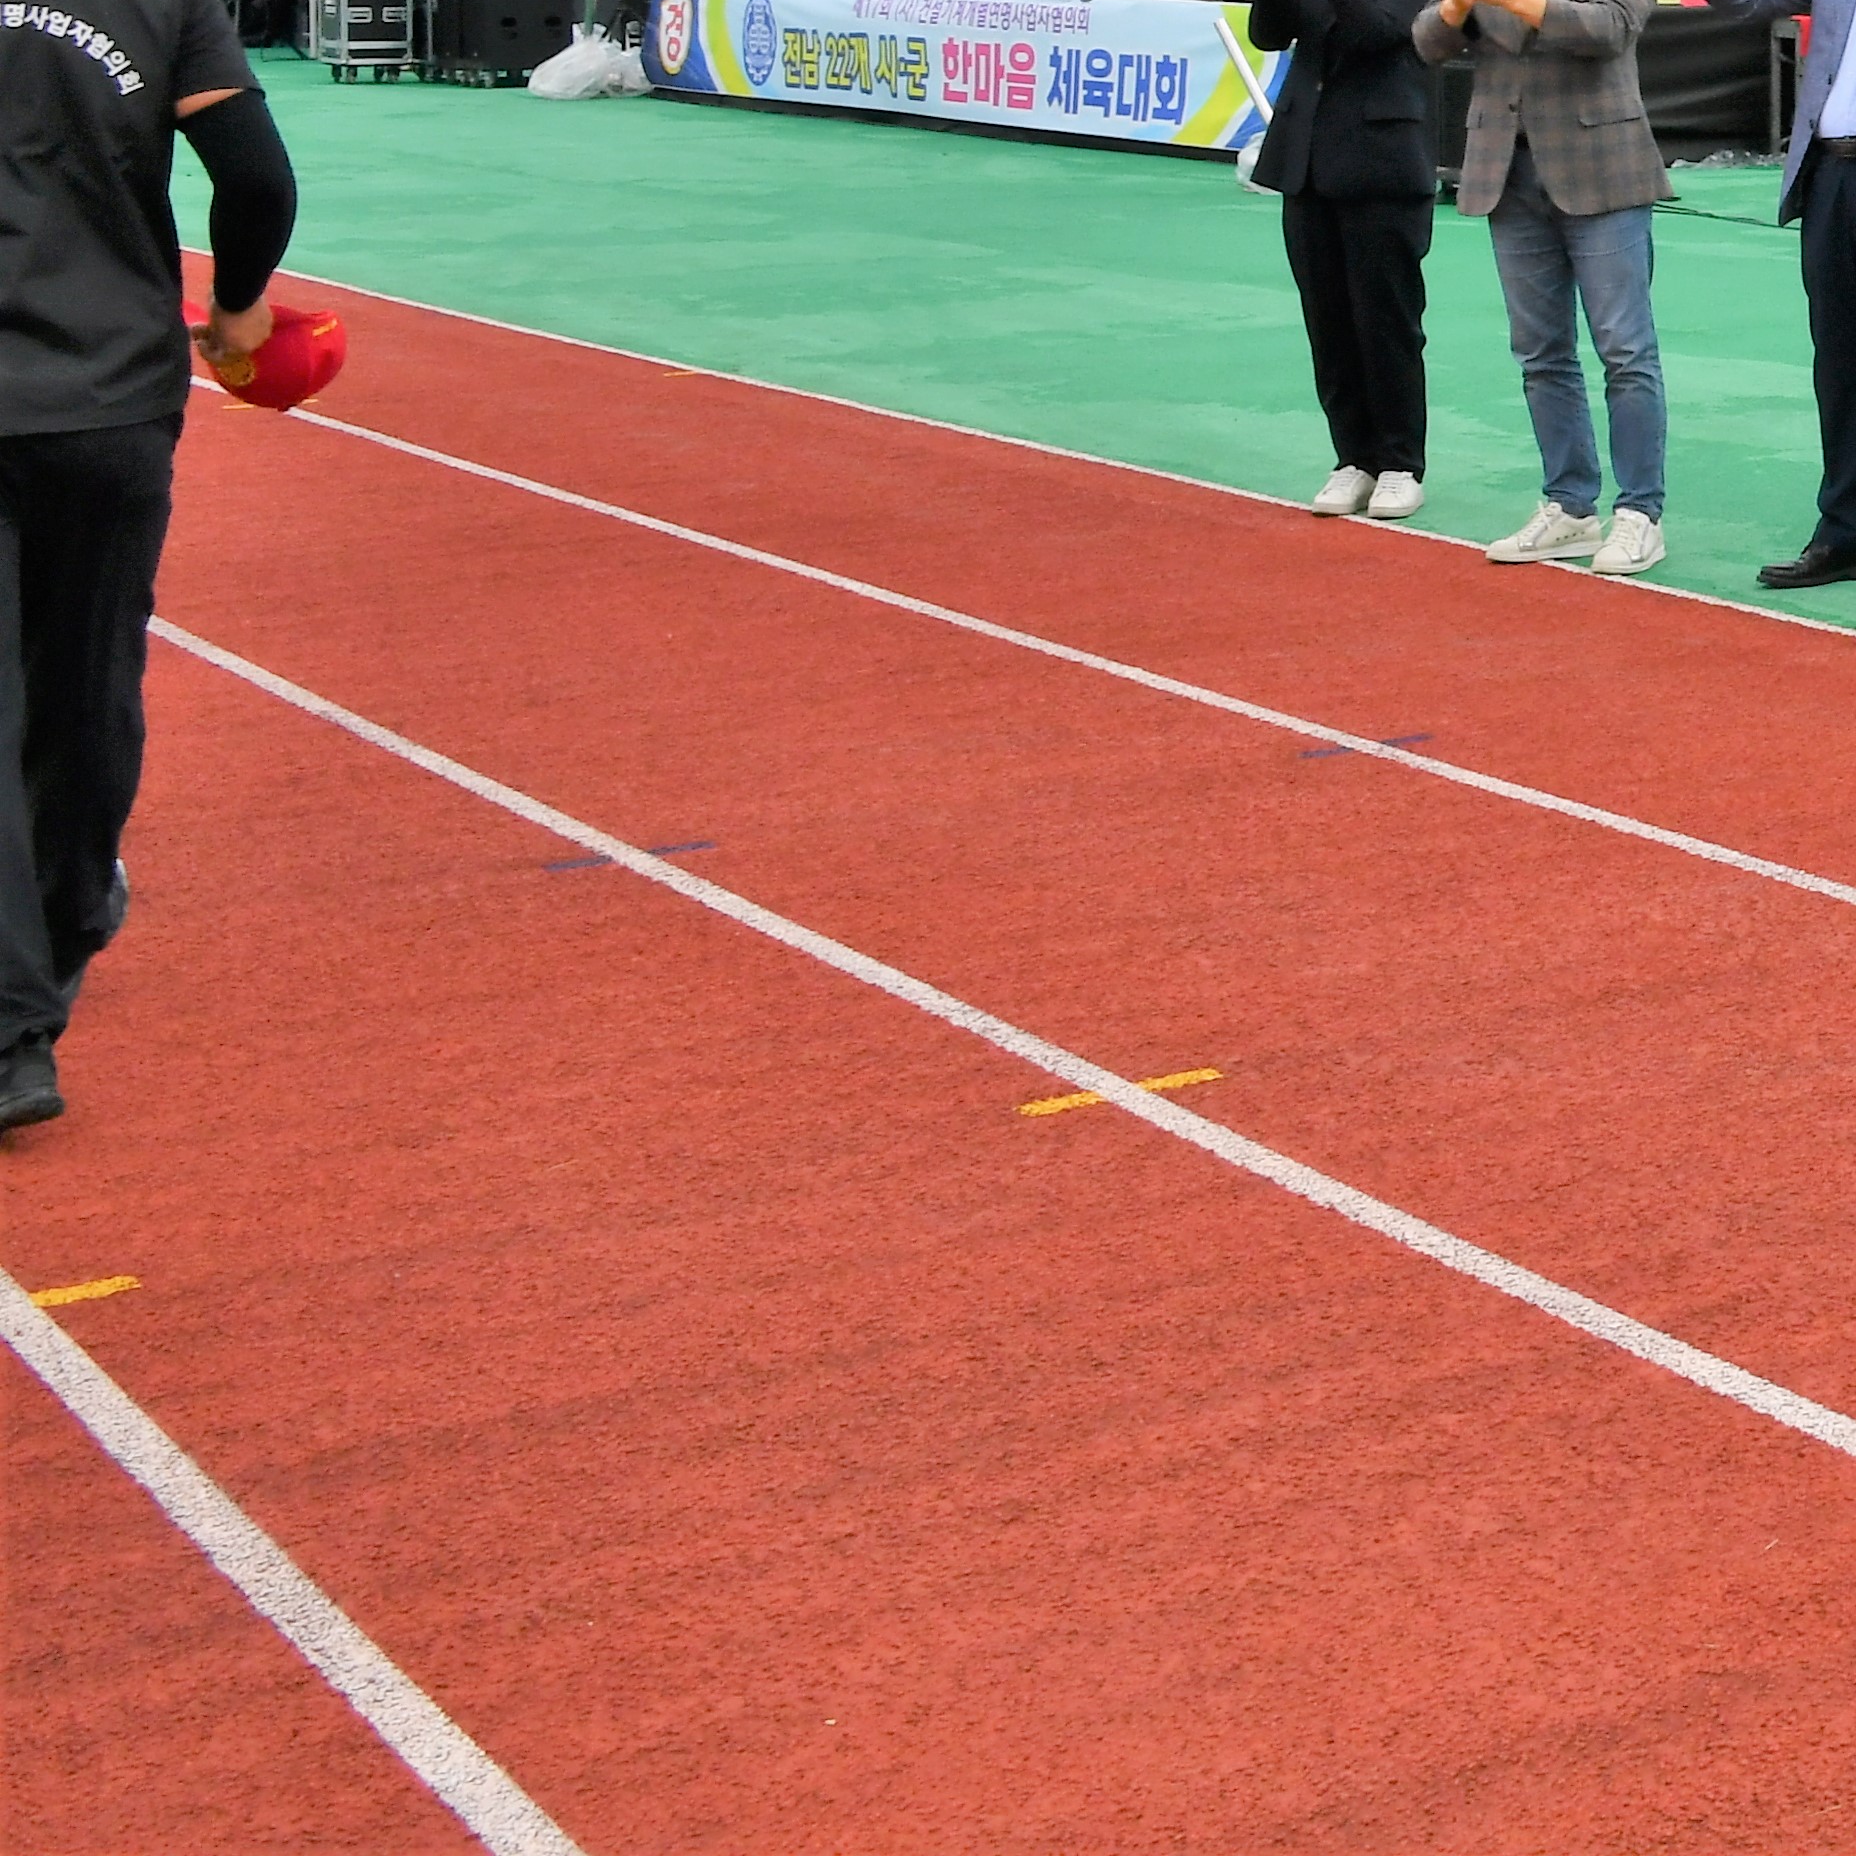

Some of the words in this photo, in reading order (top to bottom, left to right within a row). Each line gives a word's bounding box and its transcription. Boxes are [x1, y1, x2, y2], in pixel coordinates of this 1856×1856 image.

[0, 3, 145, 95] 명사업자협의회
[783, 28, 822, 90] 전남
[826, 31, 872, 94] 22개
[942, 37, 1037, 110] 한마음
[1047, 45, 1189, 125] 체육대회
